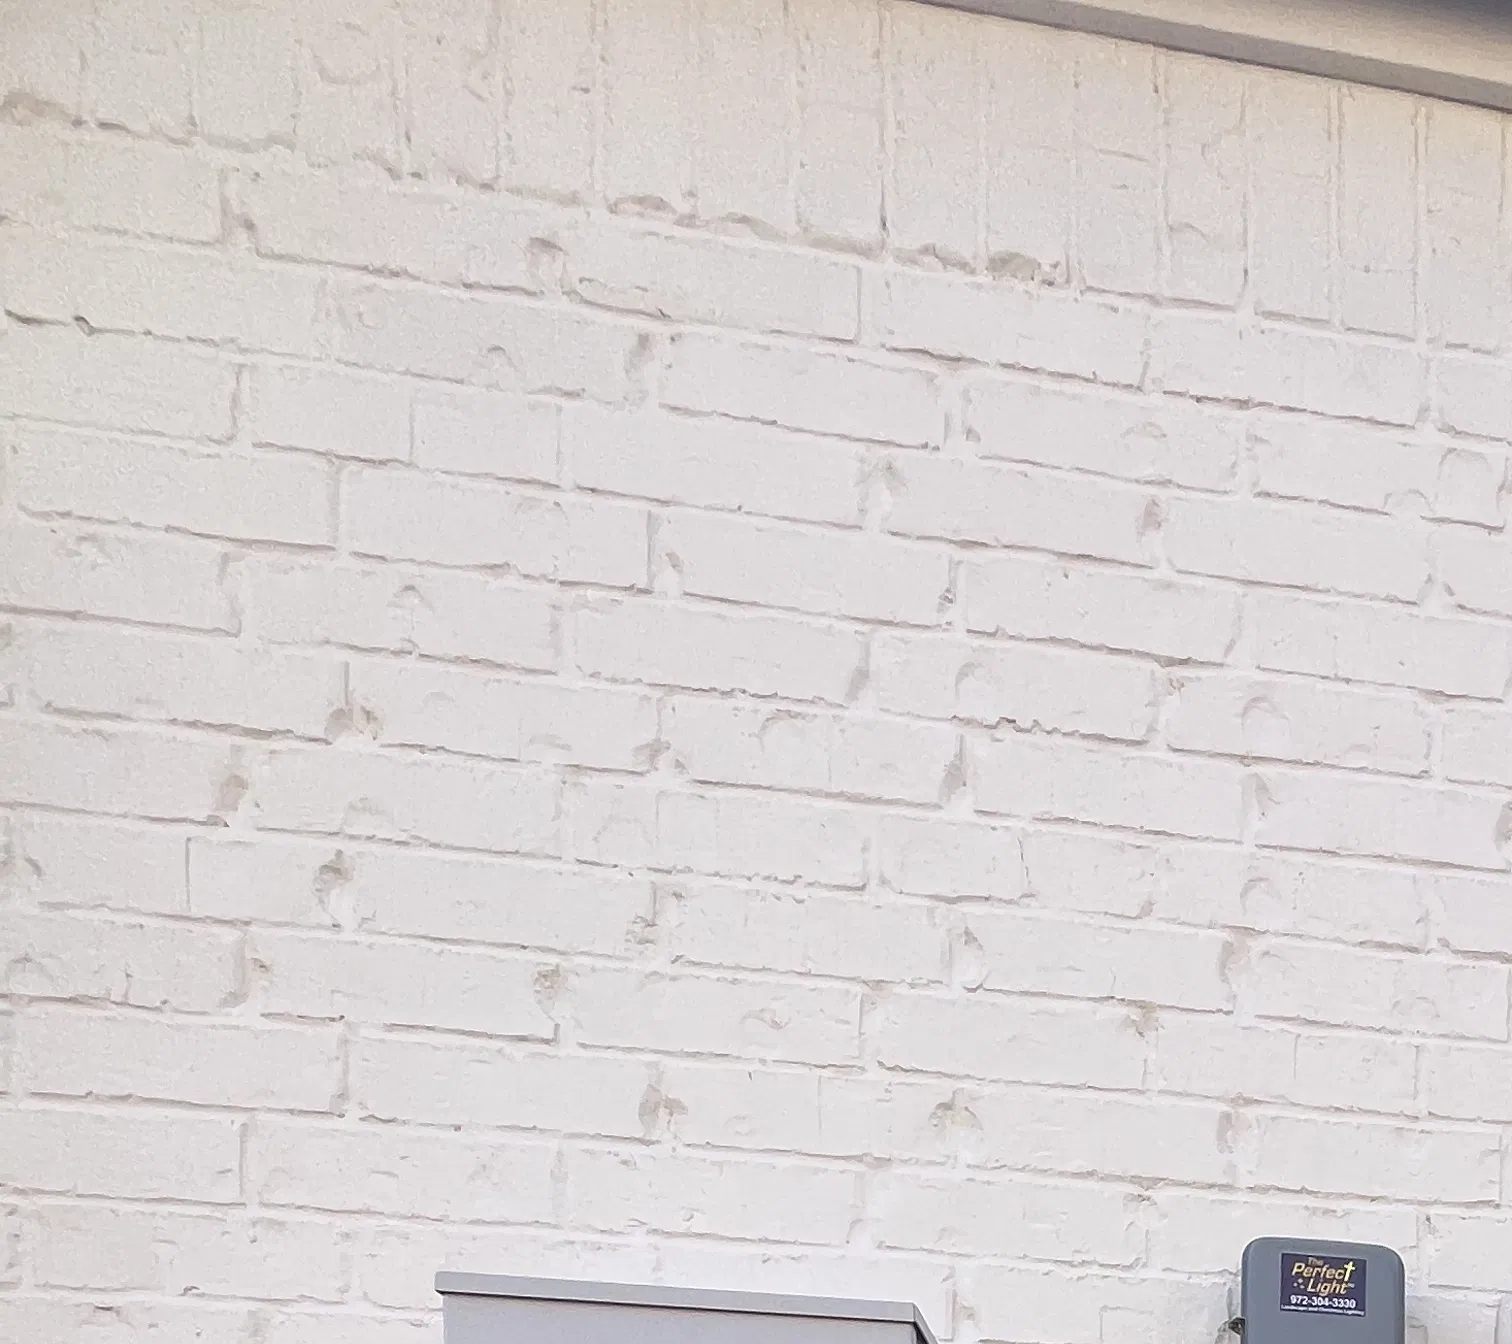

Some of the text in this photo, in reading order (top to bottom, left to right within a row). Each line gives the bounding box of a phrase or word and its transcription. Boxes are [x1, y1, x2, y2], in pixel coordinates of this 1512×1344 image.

[1291, 1261, 1356, 1281] Perfect
[1307, 1278, 1348, 1296] Light
[1290, 1294, 1357, 1309] 972-304-3330
